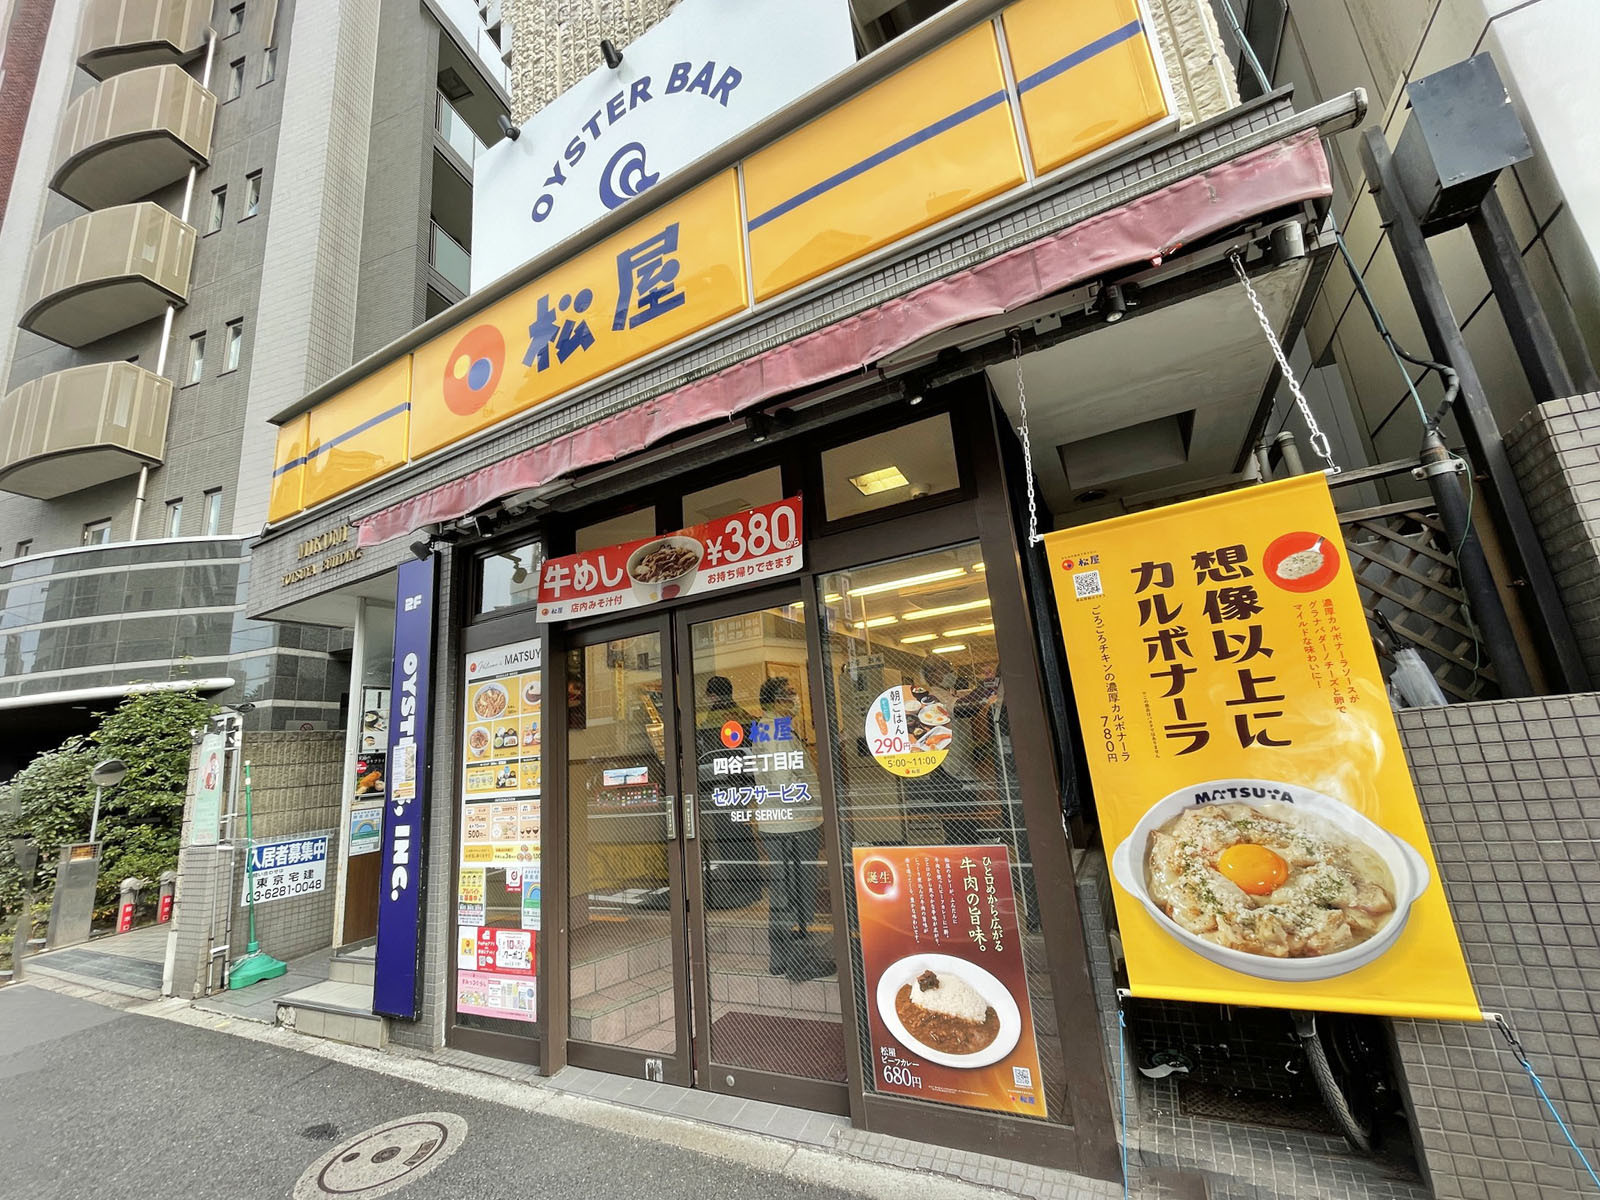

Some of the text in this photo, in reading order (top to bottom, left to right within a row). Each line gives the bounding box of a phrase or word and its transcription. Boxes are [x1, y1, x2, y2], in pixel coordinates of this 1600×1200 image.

[531, 60, 743, 223] OYSTER BAR
[522, 222, 686, 373] 松屋
[297, 525, 349, 560] MIKUNI
[706, 506, 800, 566] ¥380 から
[320, 548, 363, 573] BUILDING
[707, 554, 795, 586] お持ち帰りできます
[1078, 554, 1100, 567] 松屋
[543, 555, 624, 598] 牛めし
[405, 594, 423, 612] 2F
[571, 595, 623, 613] 店内みそ汁付
[1130, 561, 1210, 757] カルボナーラ
[1191, 543, 1293, 750] 想像以上に
[1309, 600, 1347, 714] グラナパダーノチーズと卵で
[1091, 605, 1131, 762] ごろごろチキンの濃厚カルボナーラ
[889, 690, 905, 736] 朝ごはん
[749, 716, 793, 743] 松屋
[1101, 715, 1118, 763] 780円
[874, 736, 911, 755] 290円
[713, 751, 804, 776] 四谷三丁目店
[712, 783, 812, 807] セルフサービス
[1195, 787, 1294, 805] MATSUYA
[731, 809, 794, 822] SELF SERVICE
[248, 840, 326, 870] 入居者募集中
[391, 825, 411, 901] INC.
[250, 868, 284, 878] 問い合わせは
[256, 869, 315, 889] 東京宅建
[959, 856, 988, 952] 牛肉の旨味。
[982, 856, 1004, 952] ひと口めから広がる
[881, 1046, 896, 1058] 松屋
[881, 1056, 920, 1068] ビーフカレー
[883, 1065, 922, 1090] 680円
